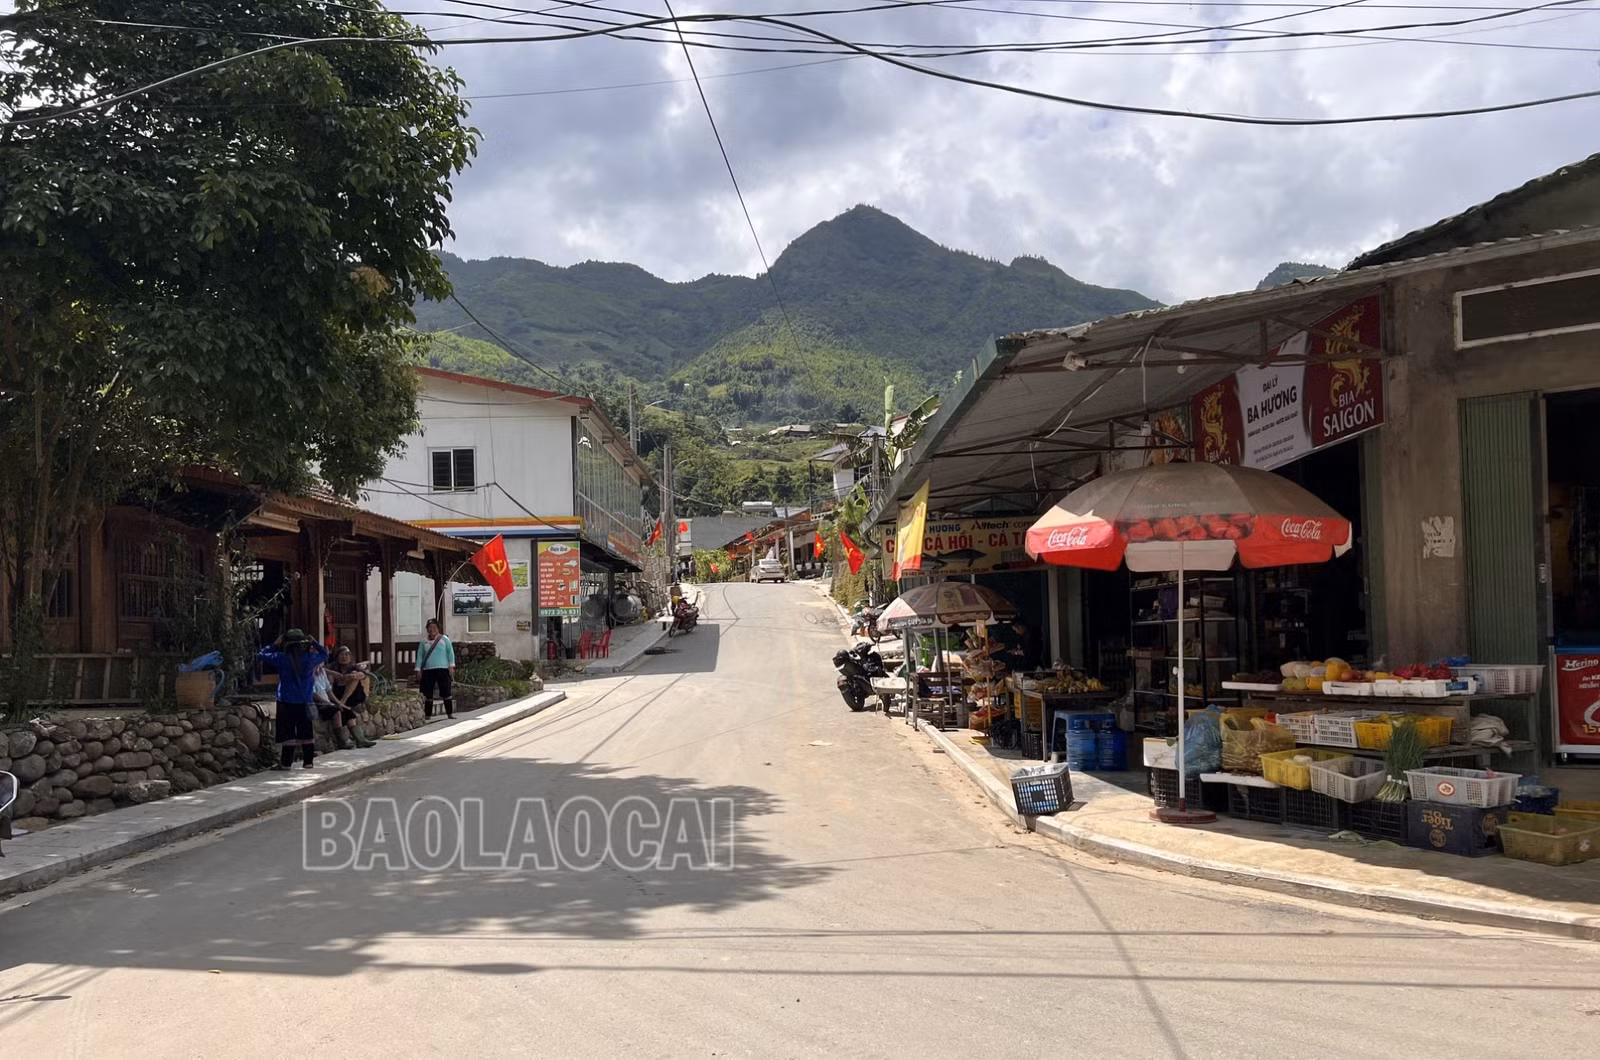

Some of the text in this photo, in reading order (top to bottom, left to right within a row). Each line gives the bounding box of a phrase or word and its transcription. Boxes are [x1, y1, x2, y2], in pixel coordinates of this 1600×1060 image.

[1247, 404, 1260, 424] BA
[1261, 385, 1298, 418] HƯƠNG
[1338, 389, 1356, 408] BIA
[1322, 397, 1376, 438] SAIGON
[924, 533, 944, 551] CÁ
[1564, 658, 1600, 671] Merino
